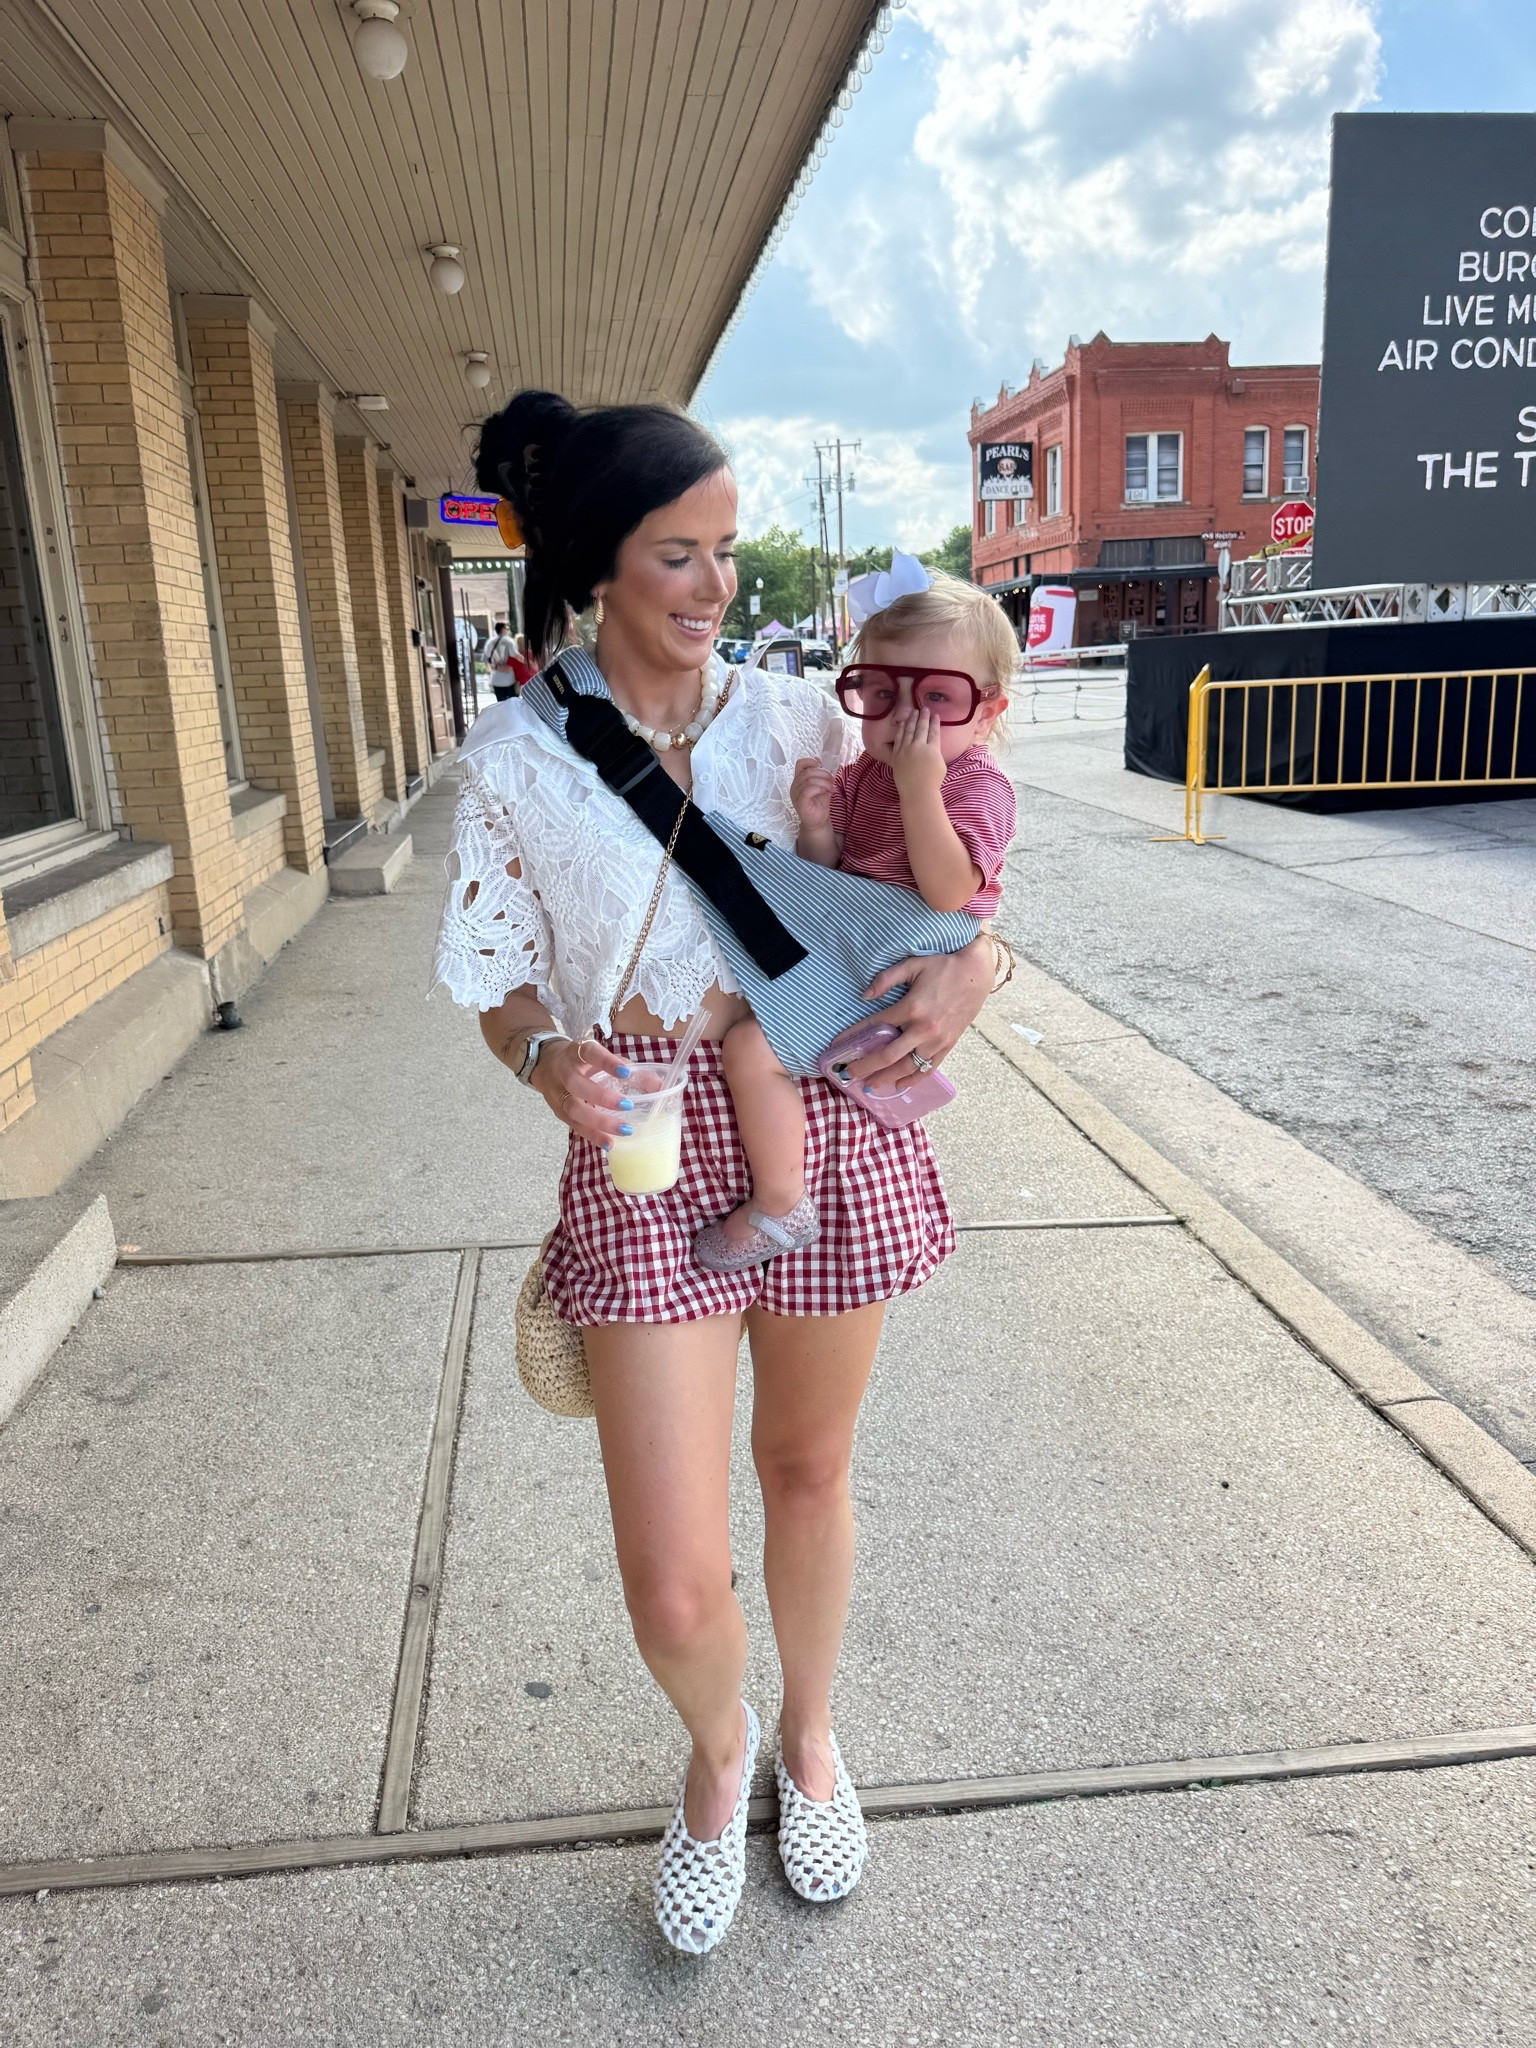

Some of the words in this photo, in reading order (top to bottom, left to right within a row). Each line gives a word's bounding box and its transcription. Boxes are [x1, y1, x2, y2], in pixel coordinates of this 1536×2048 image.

[1480, 205, 1536, 239] CO
[1458, 251, 1536, 283] BUR
[1423, 294, 1495, 326] LIVE
[1507, 294, 1536, 325] M
[1377, 339, 1439, 371] AIR
[985, 445, 1030, 462] PEARL'S
[1417, 451, 1499, 491] THE
[444, 500, 494, 521] OPE
[1274, 516, 1315, 536] STOP
[1028, 624, 1046, 633] TAR
[1029, 614, 1046, 624] ONE
